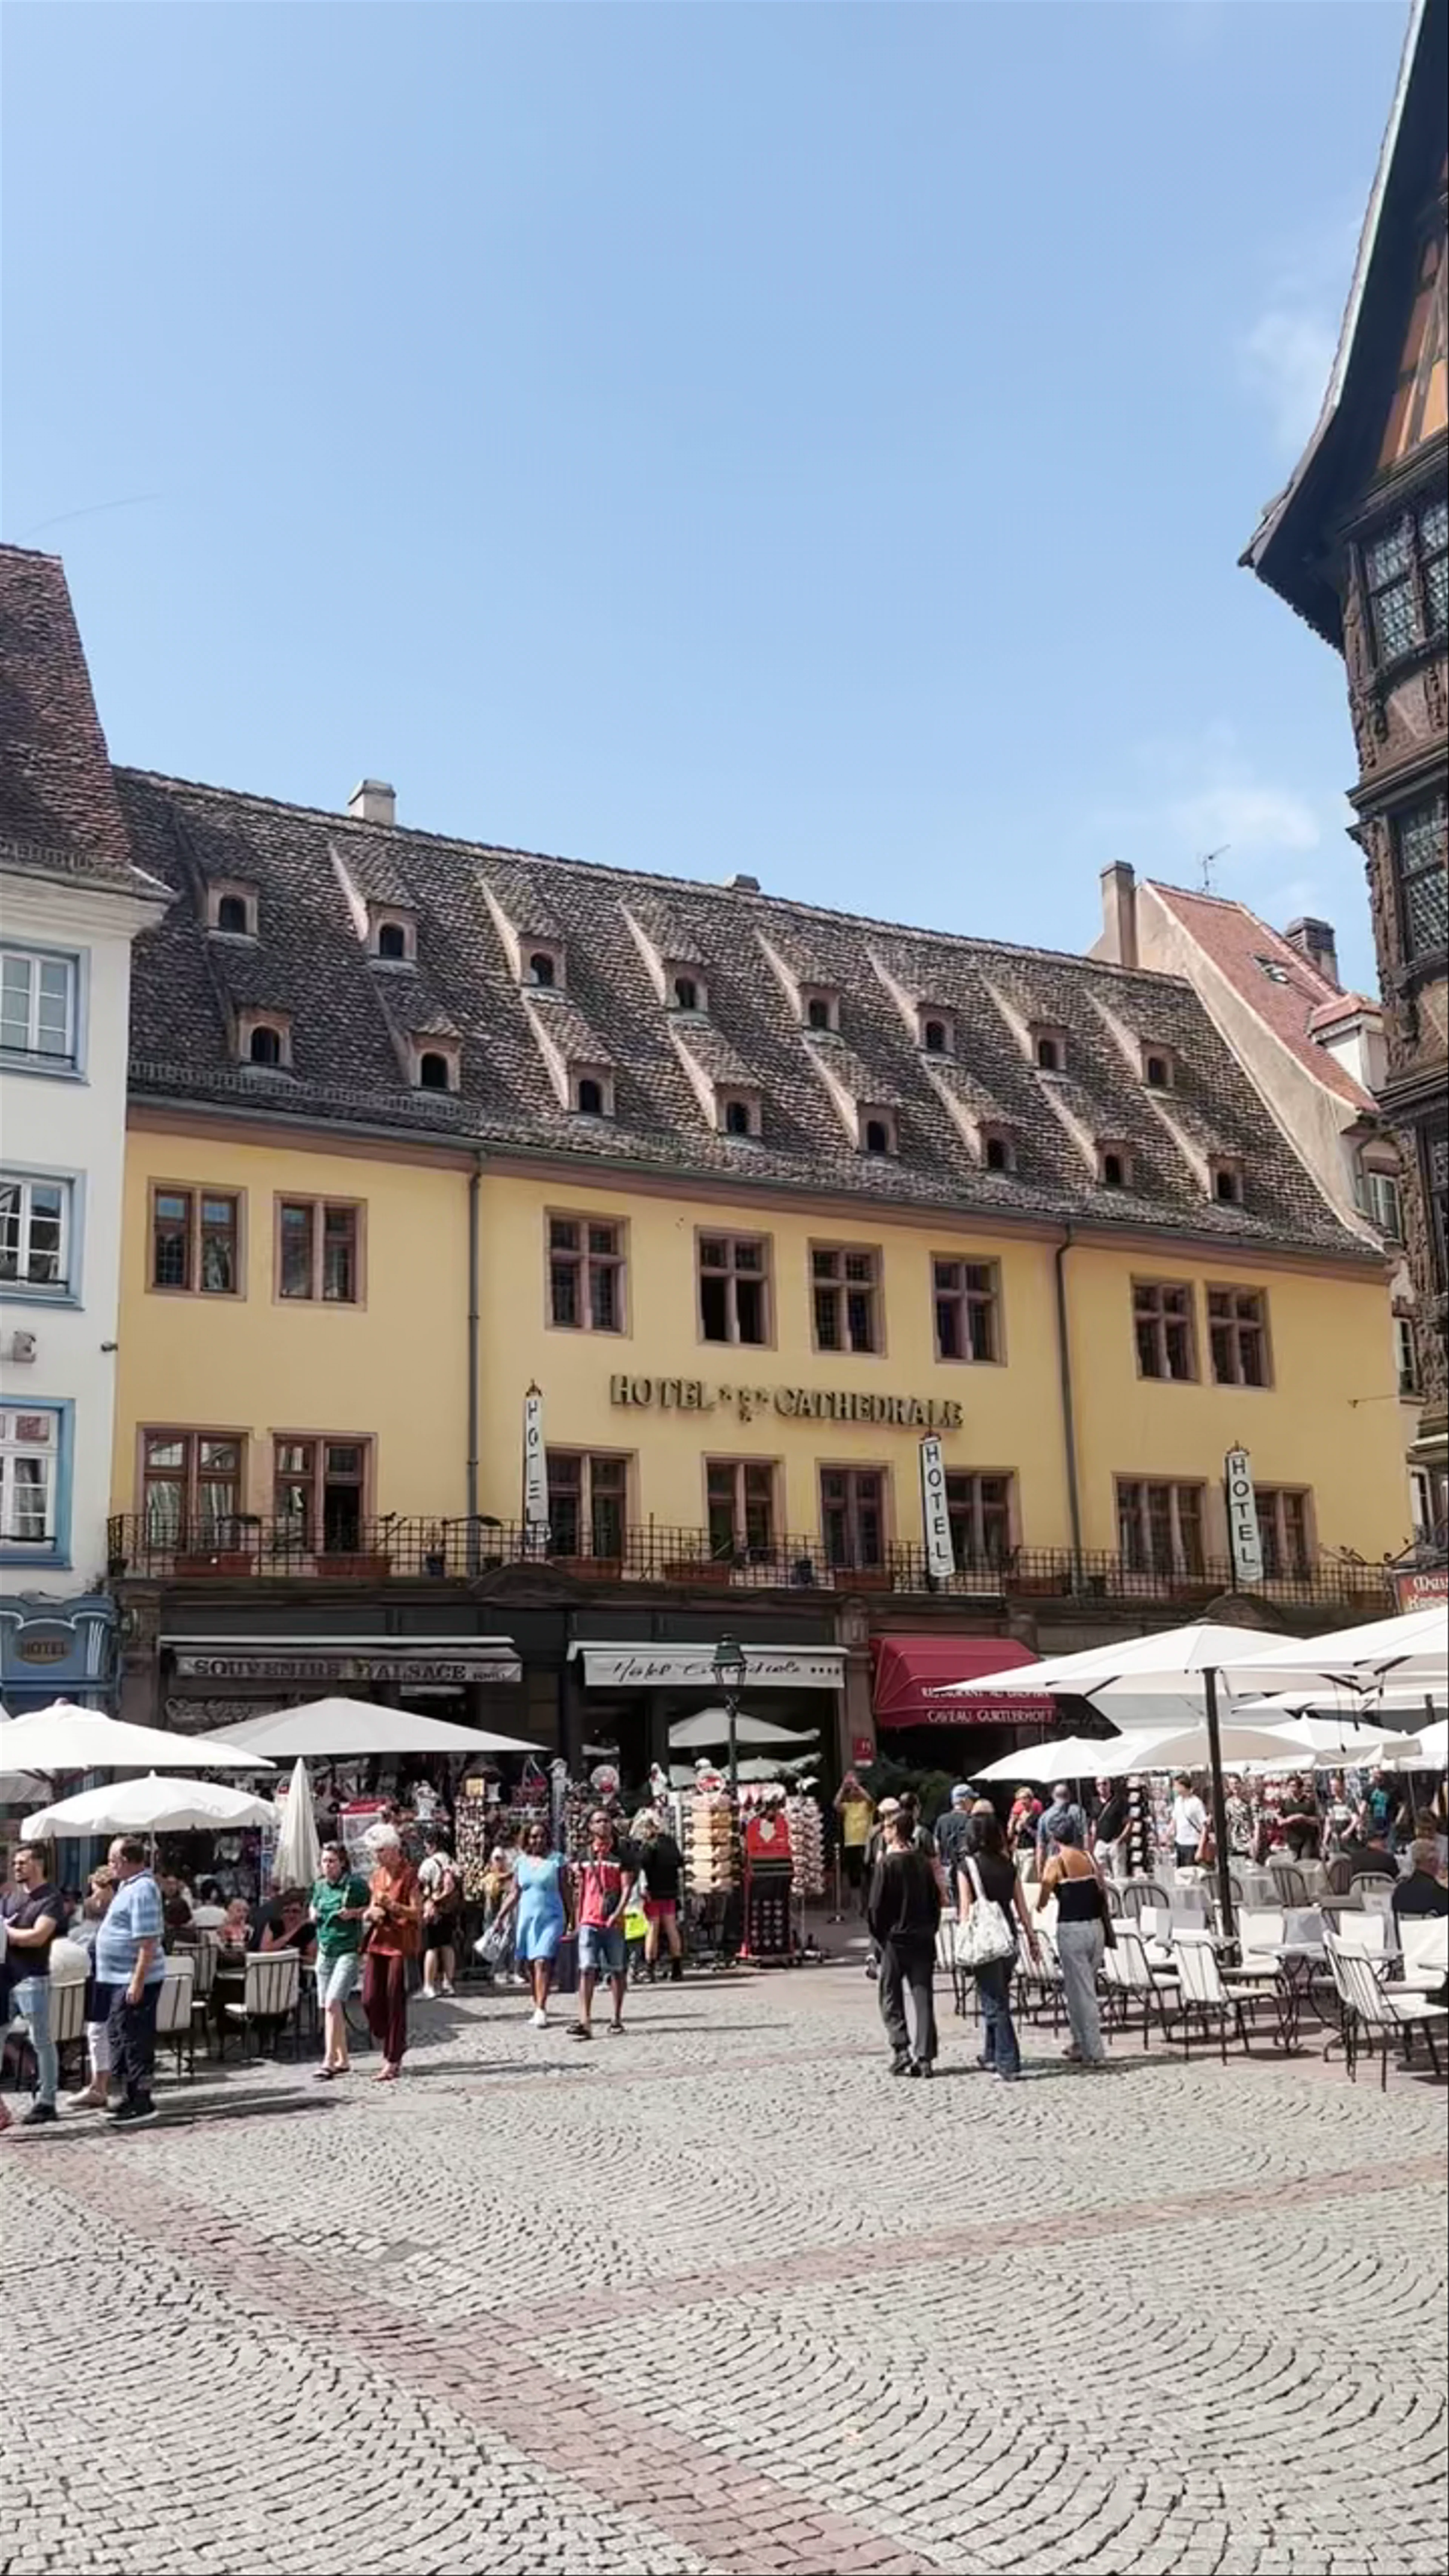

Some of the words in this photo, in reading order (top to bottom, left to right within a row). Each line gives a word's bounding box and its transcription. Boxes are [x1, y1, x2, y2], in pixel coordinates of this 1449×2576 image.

[610, 1375, 714, 1411] HOTEL
[774, 1387, 964, 1429] CATHEDRALE
[925, 1444, 949, 1559] HOTEL
[1232, 1458, 1256, 1564] HOTEL
[194, 1659, 341, 1676] SOUVENIRS
